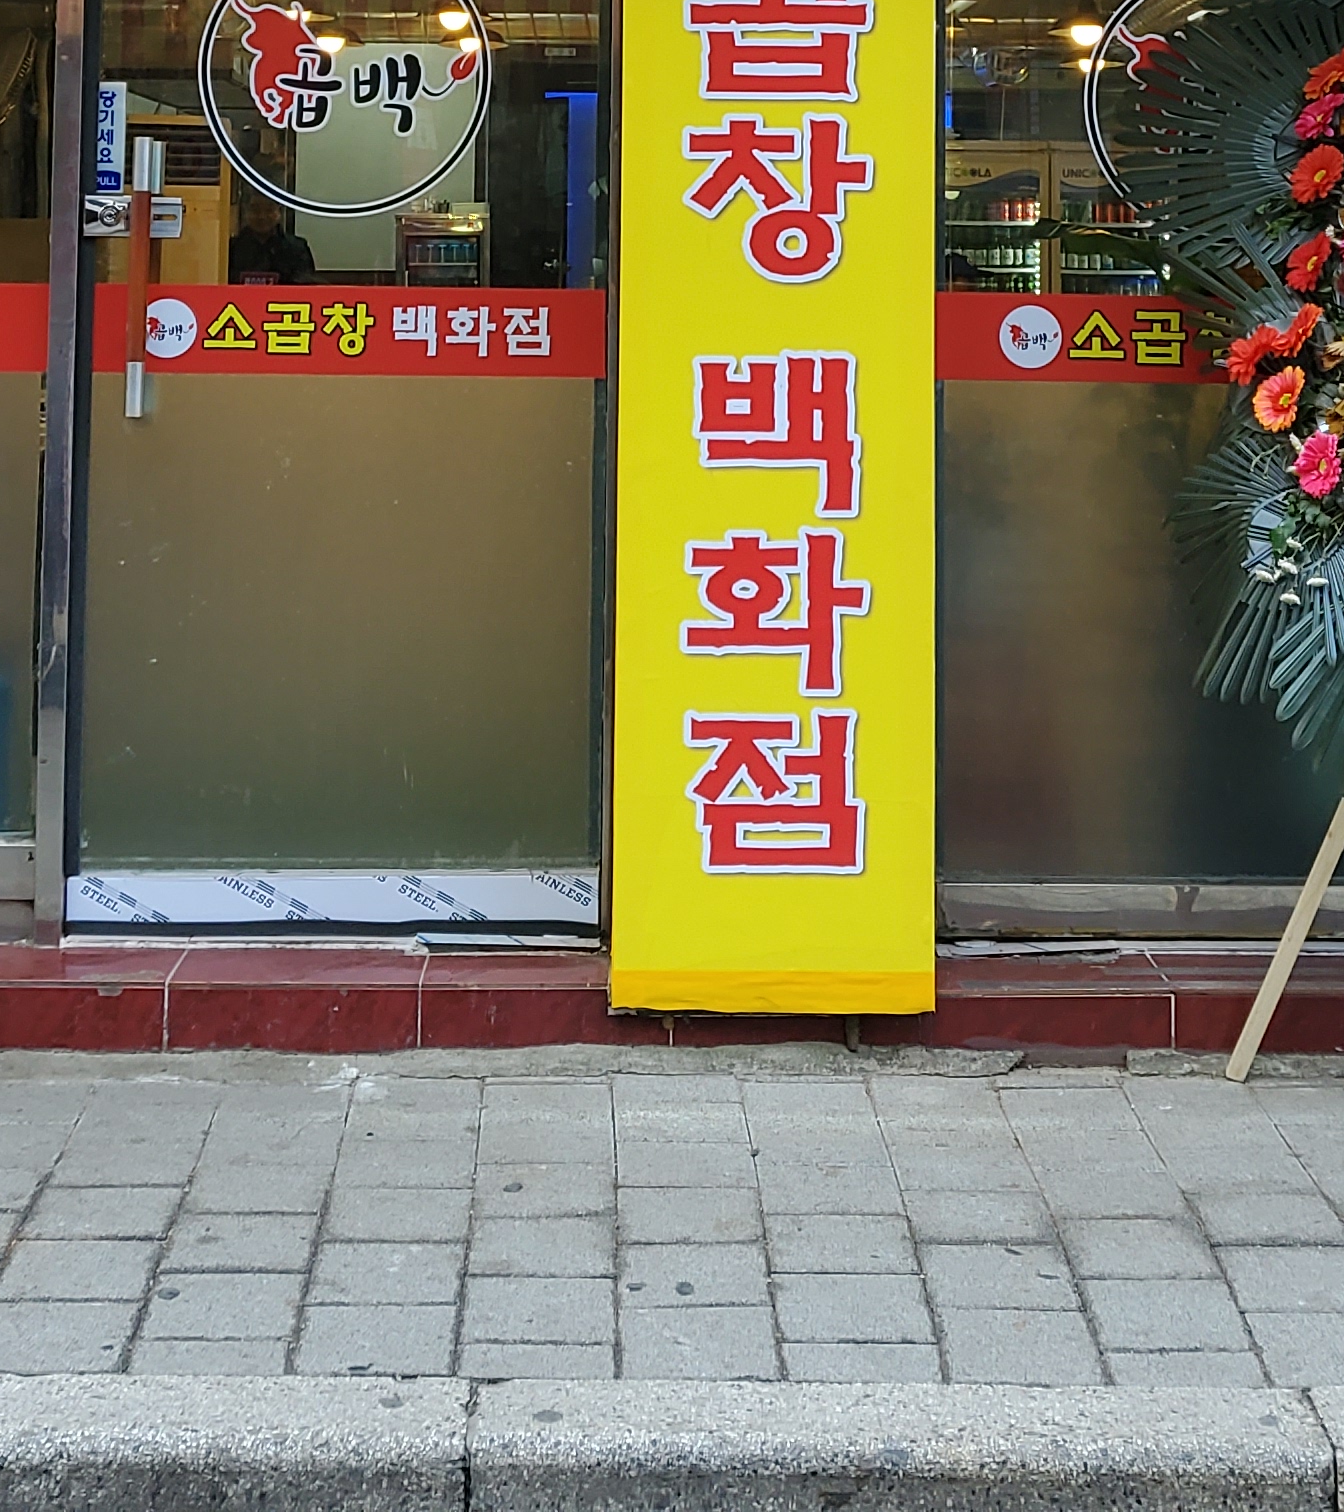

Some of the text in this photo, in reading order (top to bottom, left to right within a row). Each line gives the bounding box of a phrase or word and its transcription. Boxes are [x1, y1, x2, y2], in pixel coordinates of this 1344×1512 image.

[97, 90, 117, 164] 당기세요
[202, 301, 553, 358] 소곱창 백화점
[679, 348, 866, 874] 백화점
